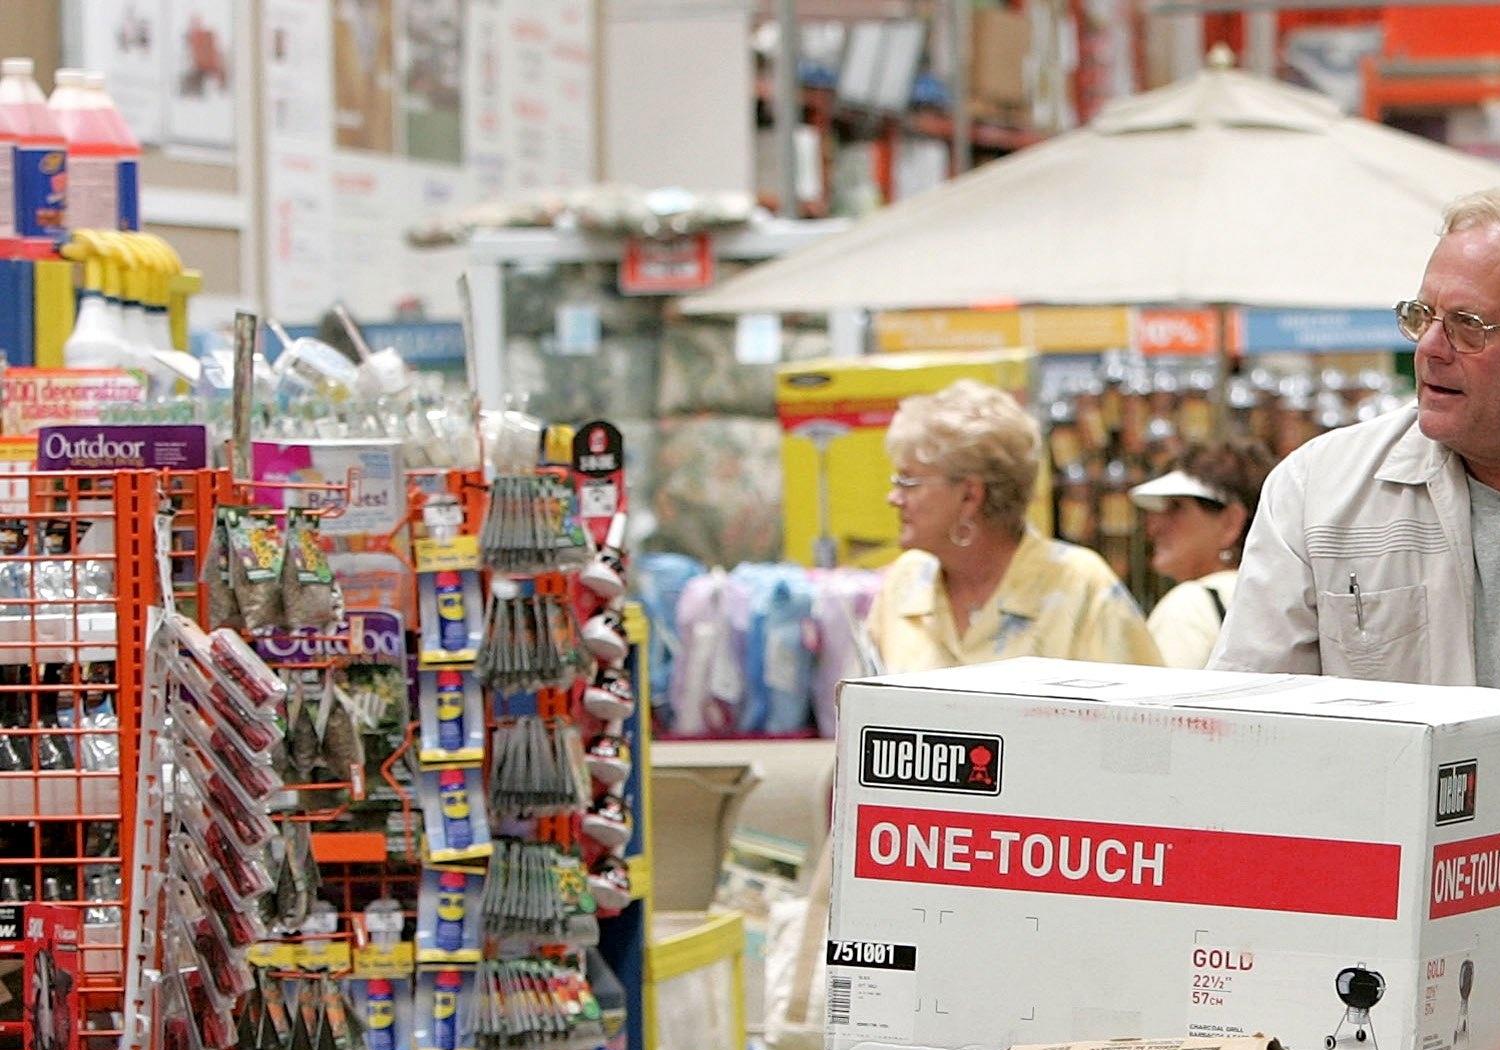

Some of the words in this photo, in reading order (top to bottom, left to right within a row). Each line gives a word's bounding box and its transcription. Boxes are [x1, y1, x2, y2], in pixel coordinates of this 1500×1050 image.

[45, 432, 146, 460] Outdoor
[872, 734, 966, 783] weber
[1439, 767, 1468, 815] weber
[869, 821, 1167, 887] ONE-TOUCH
[832, 941, 895, 965] 751001
[1193, 949, 1253, 971] GOLD
